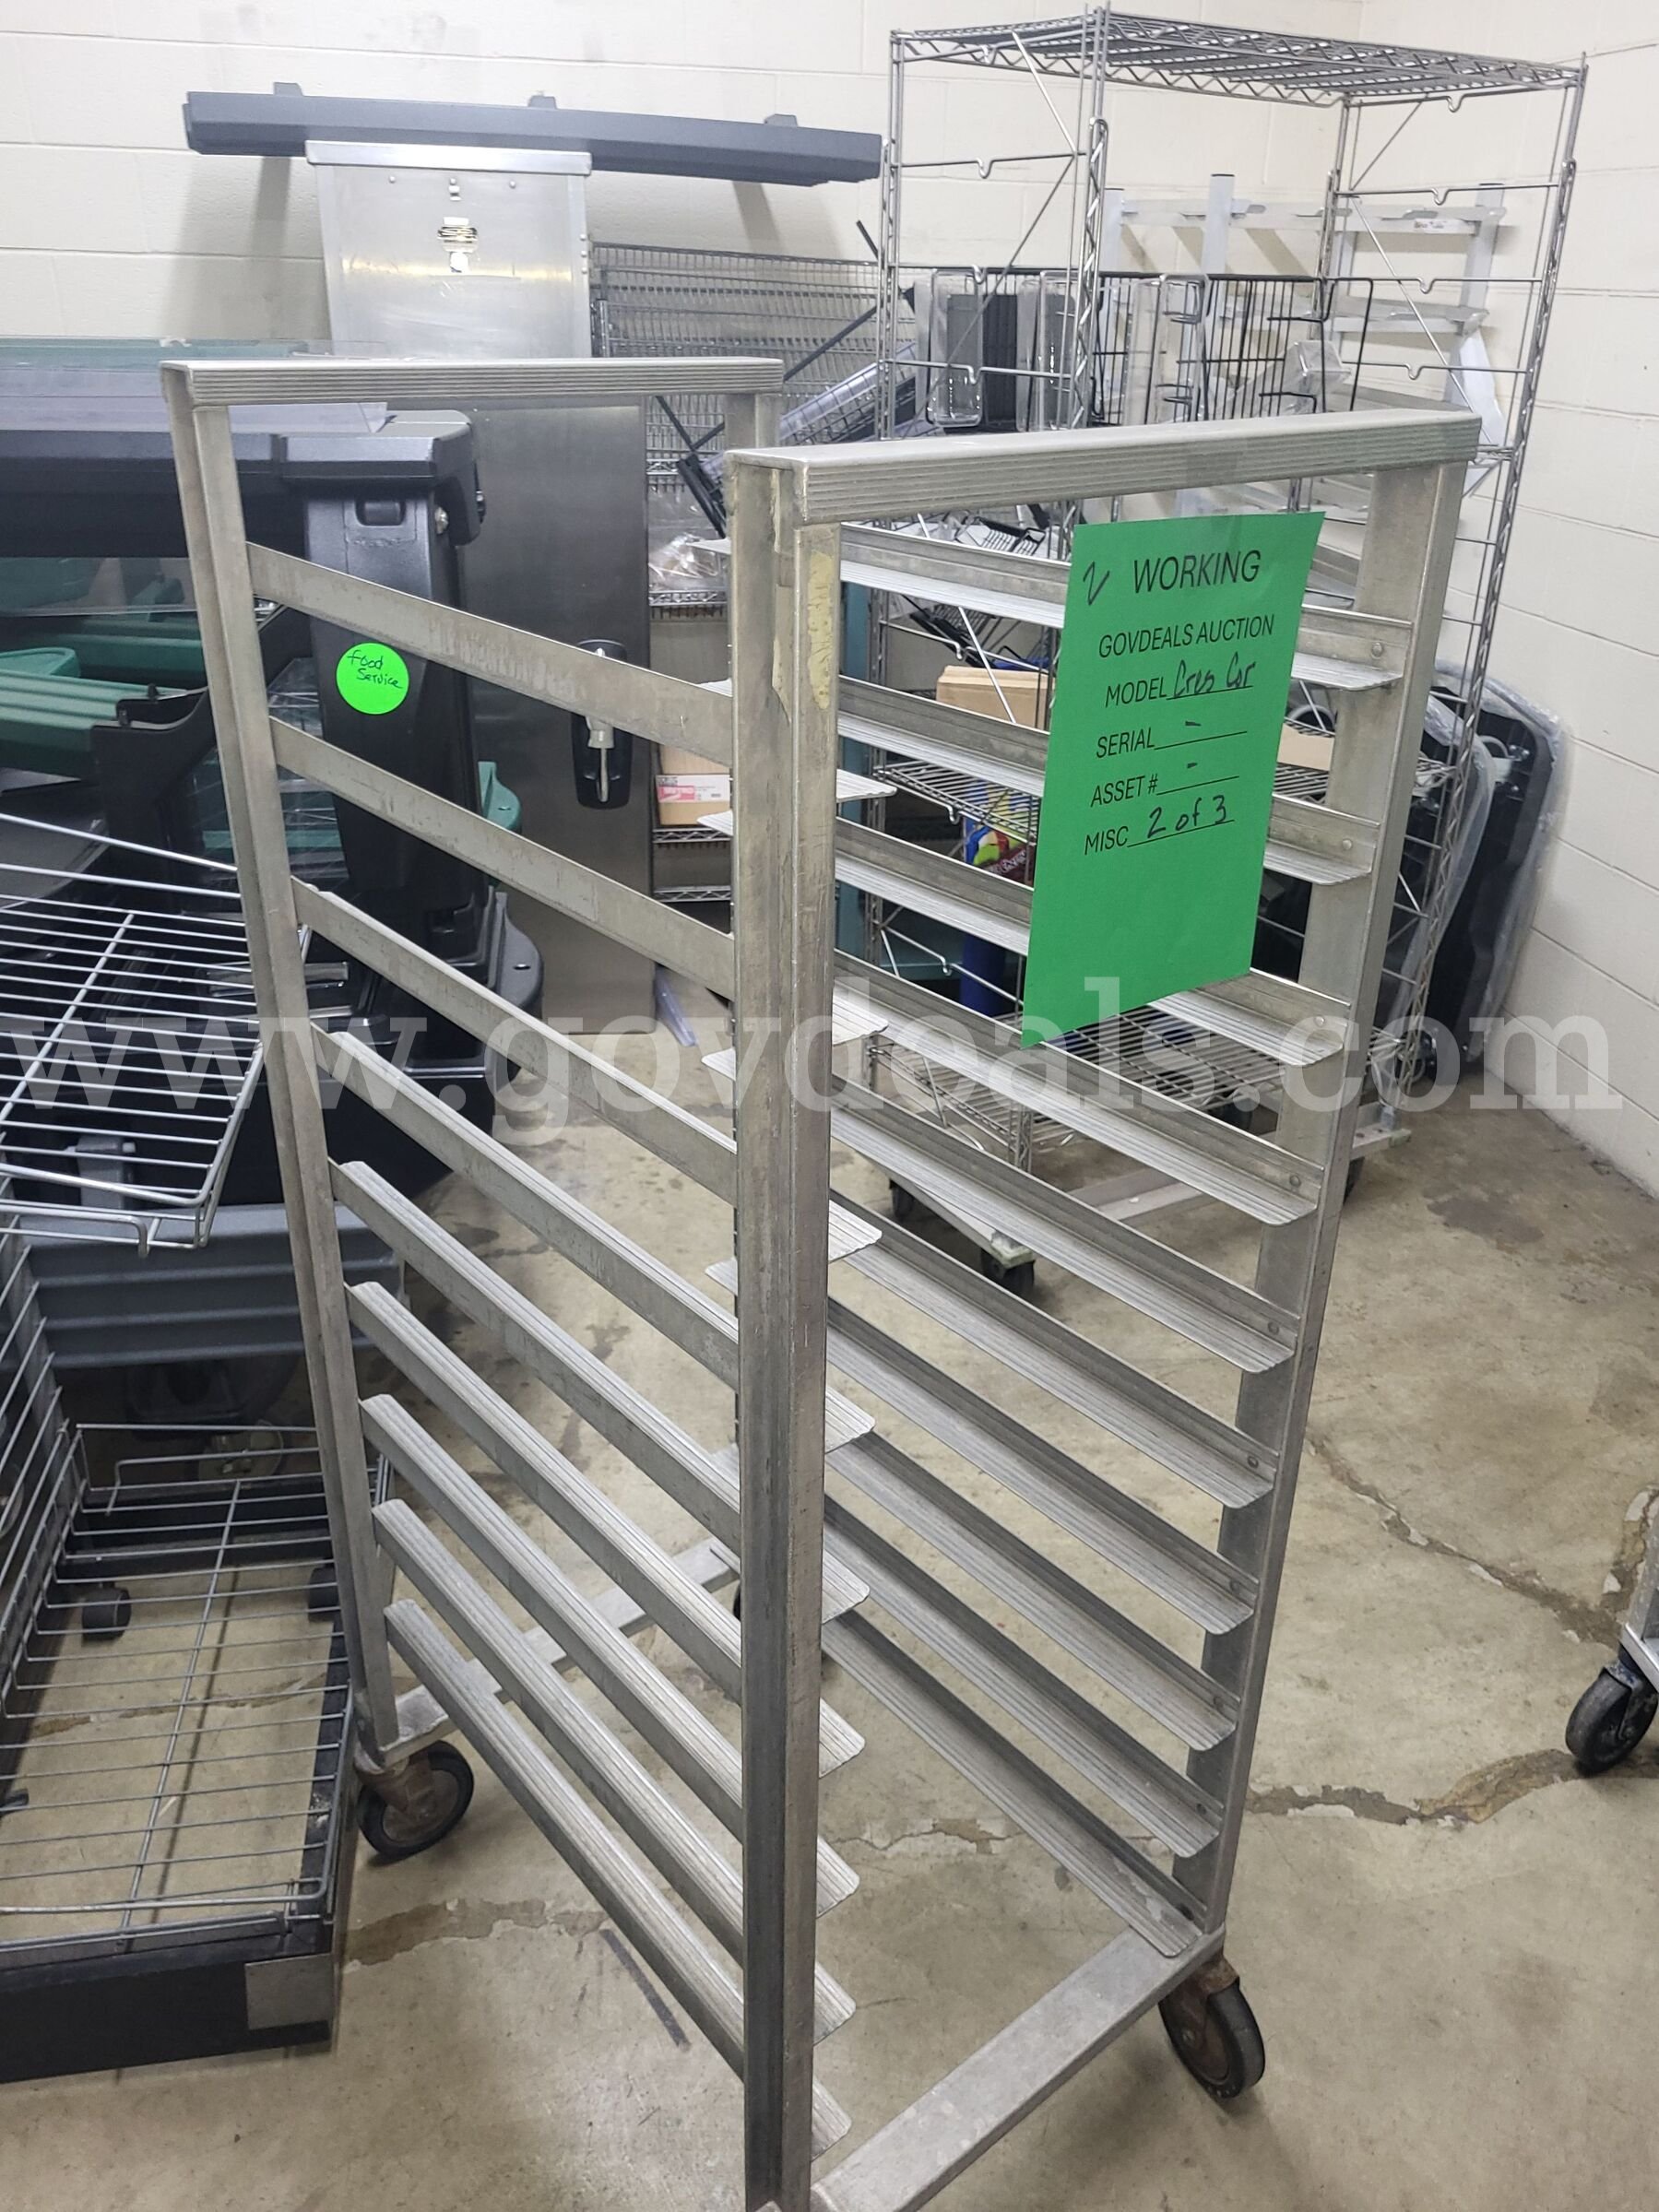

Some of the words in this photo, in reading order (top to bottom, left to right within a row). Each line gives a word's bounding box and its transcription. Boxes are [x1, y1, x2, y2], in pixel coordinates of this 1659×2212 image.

[1133, 550, 1262, 593] WORKING
[1098, 623, 1193, 657] GOVDEALS
[1196, 615, 1274, 644] AUCTION
[1106, 677, 1167, 707] MODEL
[1096, 727, 1155, 759] SERIAL
[1090, 775, 1145, 807] ASSET
[1147, 807, 1166, 838] 2
[1175, 796, 1203, 832] of
[1213, 794, 1226, 823] 3
[1084, 826, 1129, 856] MISC
